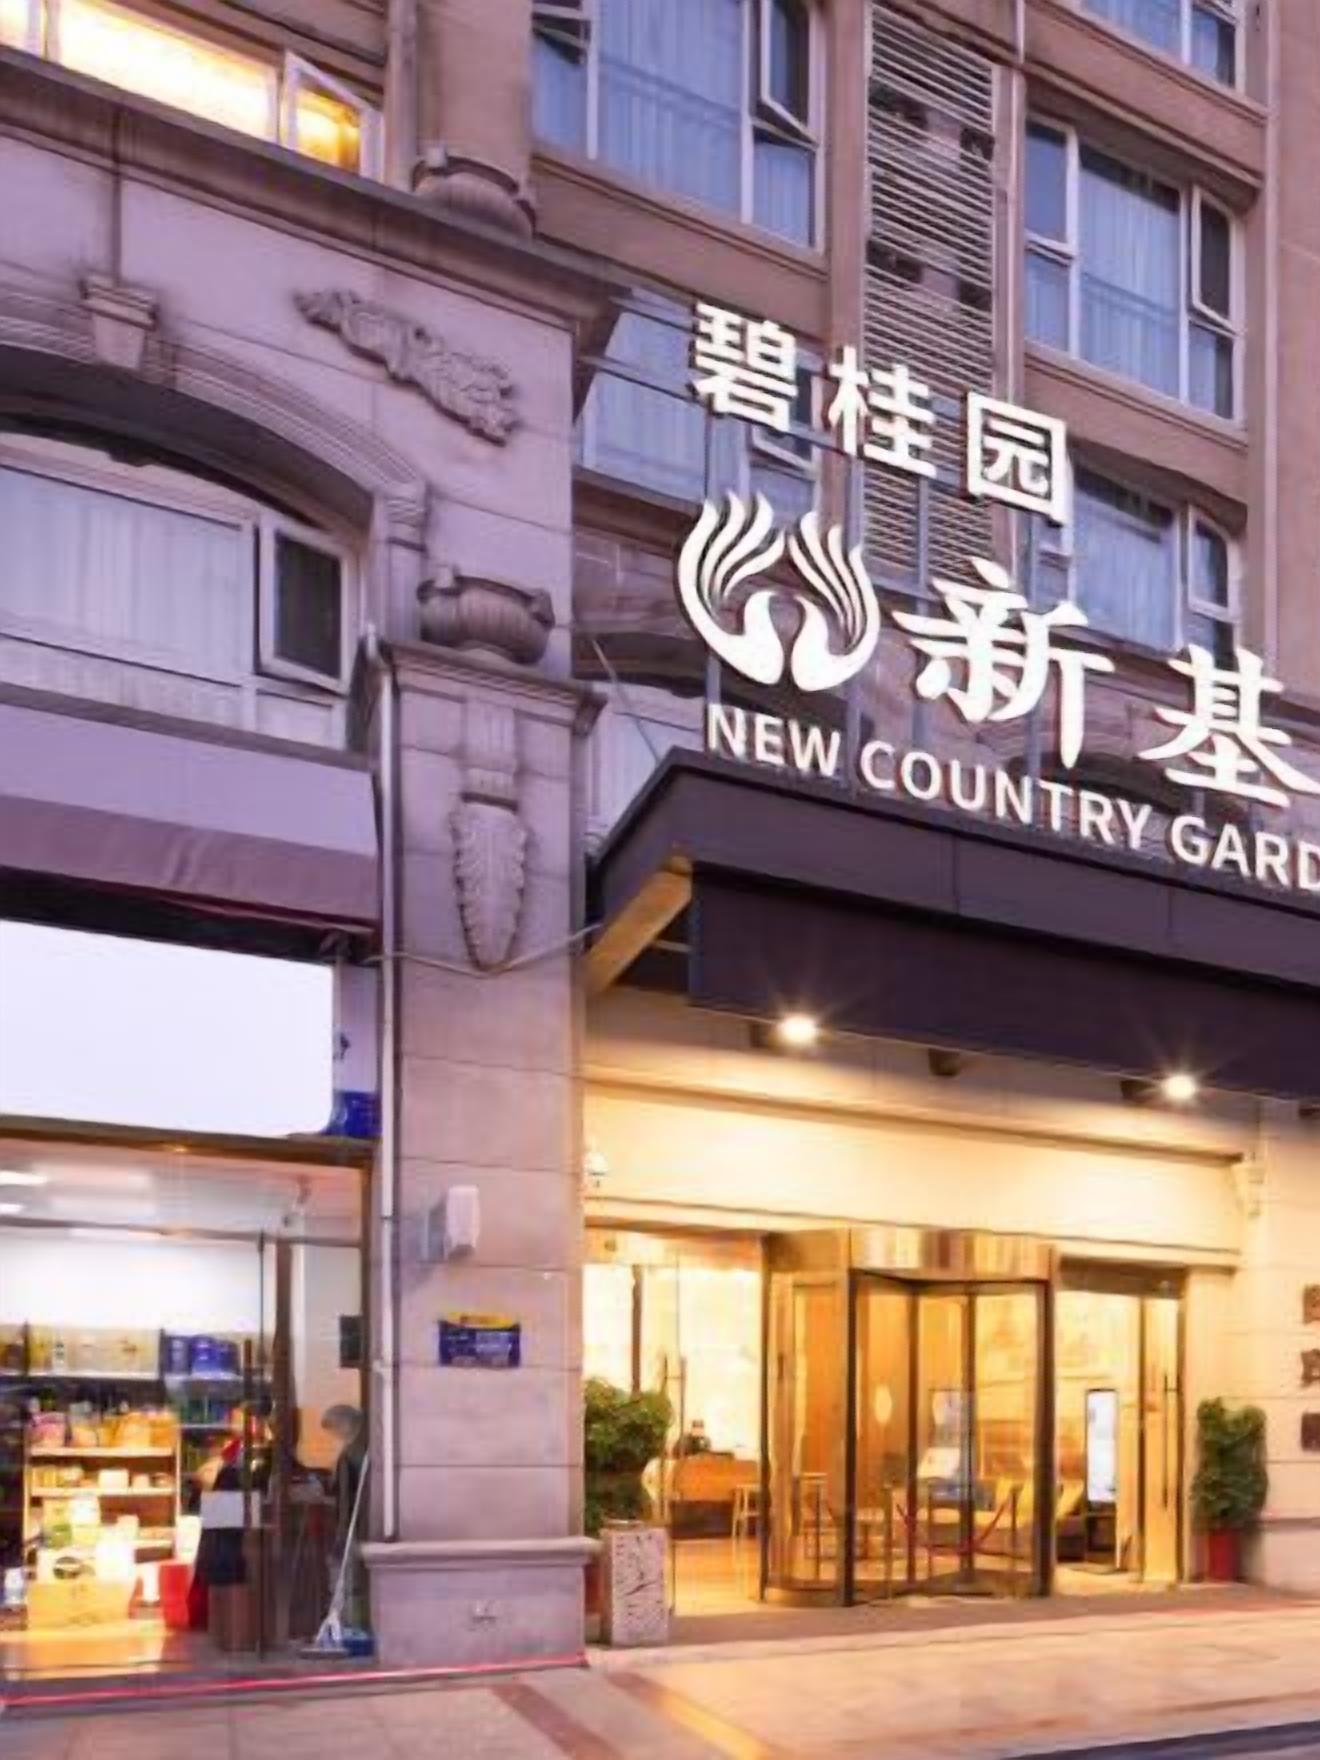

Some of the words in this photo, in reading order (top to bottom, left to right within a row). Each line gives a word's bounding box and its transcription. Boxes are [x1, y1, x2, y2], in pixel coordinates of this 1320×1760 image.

[692, 302, 1071, 525] 碧桂园
[707, 703, 841, 778] NEW
[859, 739, 1153, 850] COUNTRY
